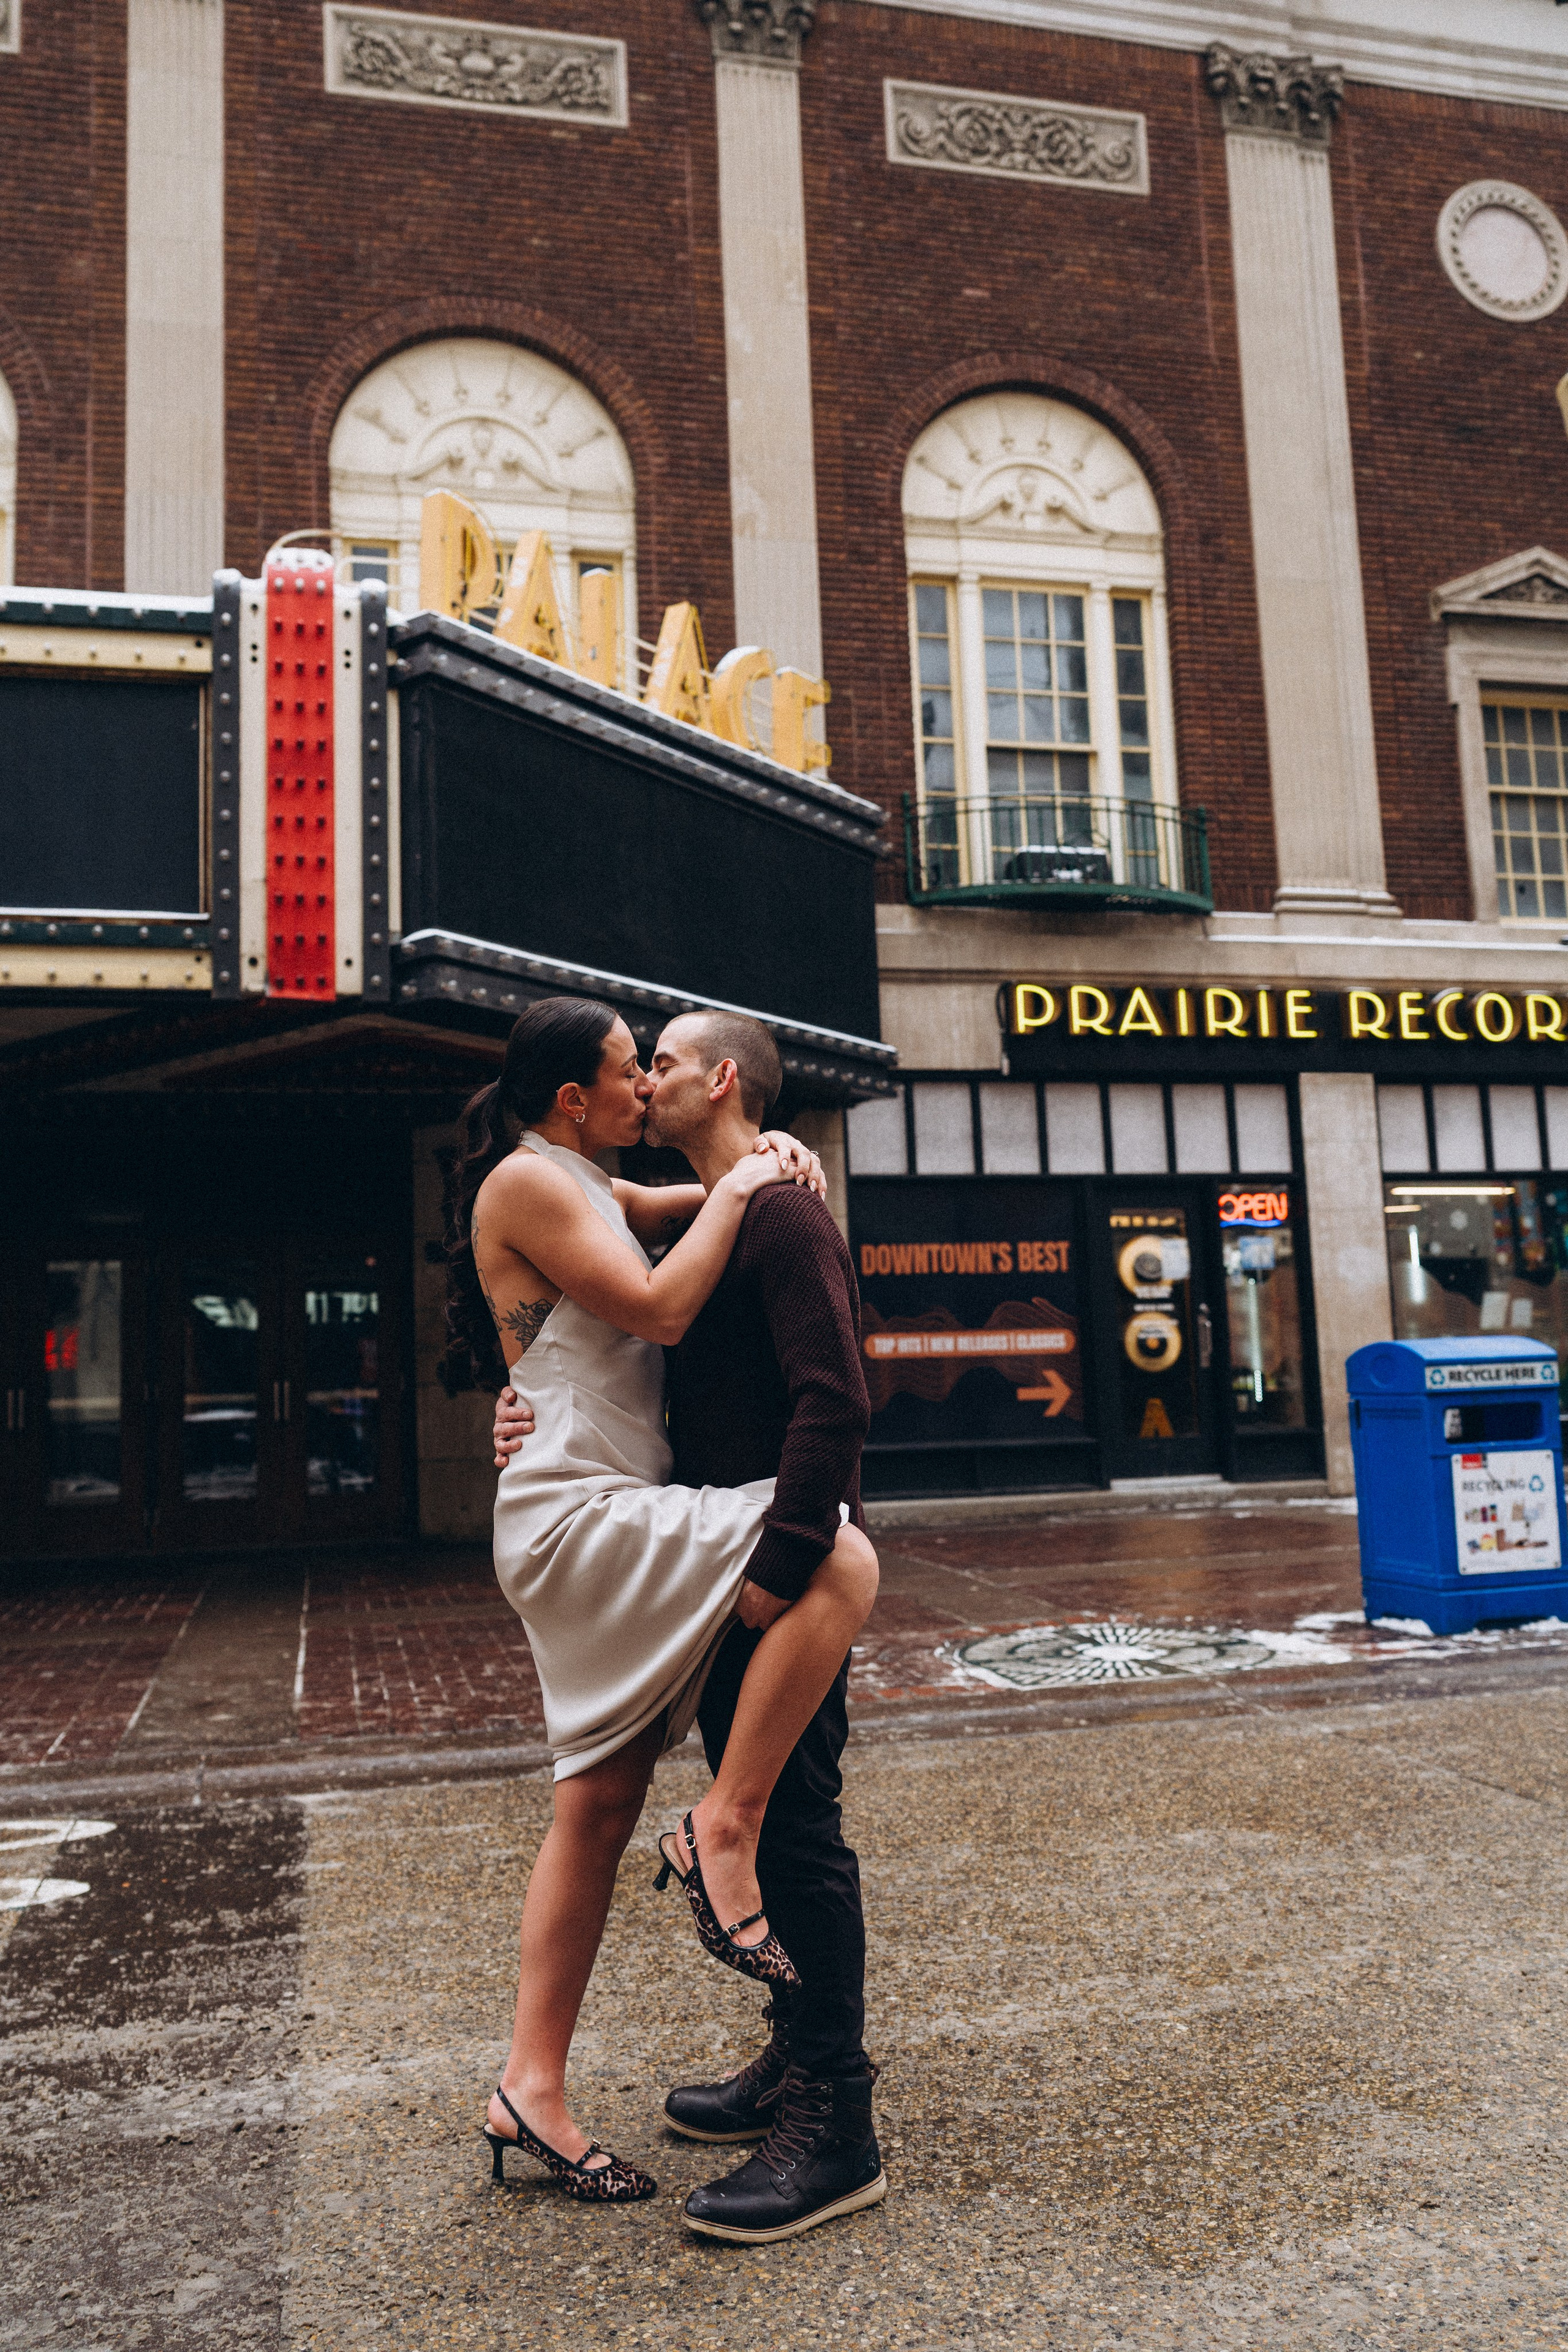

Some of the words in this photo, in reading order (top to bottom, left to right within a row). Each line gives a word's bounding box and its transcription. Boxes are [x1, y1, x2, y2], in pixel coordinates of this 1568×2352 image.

[1015, 982, 1318, 1039] PRAIRIE
[1349, 990, 1566, 1042] RECOR
[1218, 1193, 1289, 1221] OPEN
[861, 1242, 1013, 1275] DOWNTOWN'S
[1017, 1240, 1071, 1273] BEST
[1449, 1368, 1501, 1382] RECYCLE
[1504, 1366, 1536, 1379] HERE
